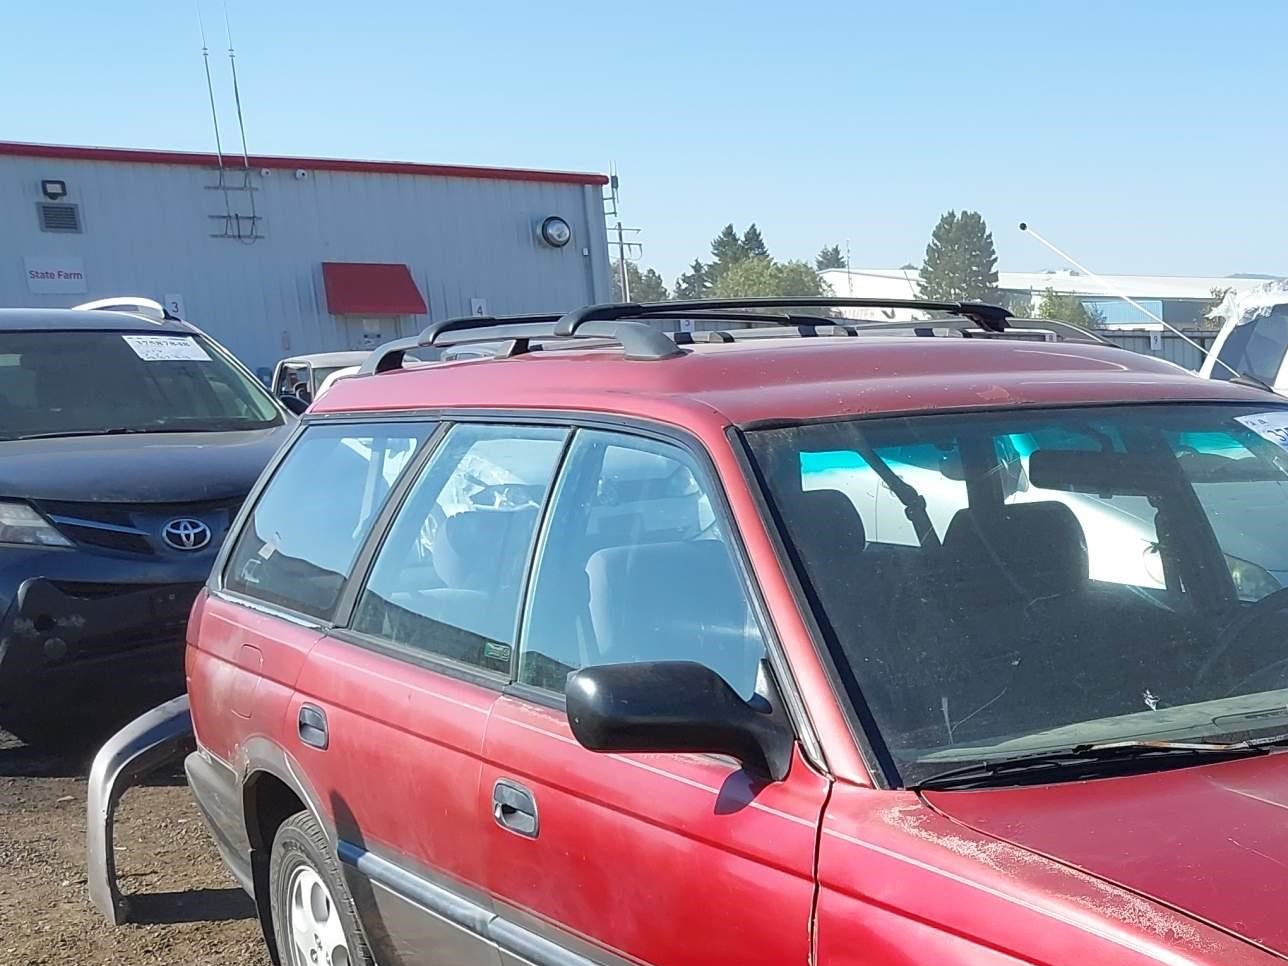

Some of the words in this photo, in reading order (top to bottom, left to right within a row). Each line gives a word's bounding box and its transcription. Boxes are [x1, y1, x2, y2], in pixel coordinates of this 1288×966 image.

[29, 270, 55, 280] State
[57, 270, 83, 280] Farm
[171, 301, 179, 313] 3
[476, 305, 483, 316] 4
